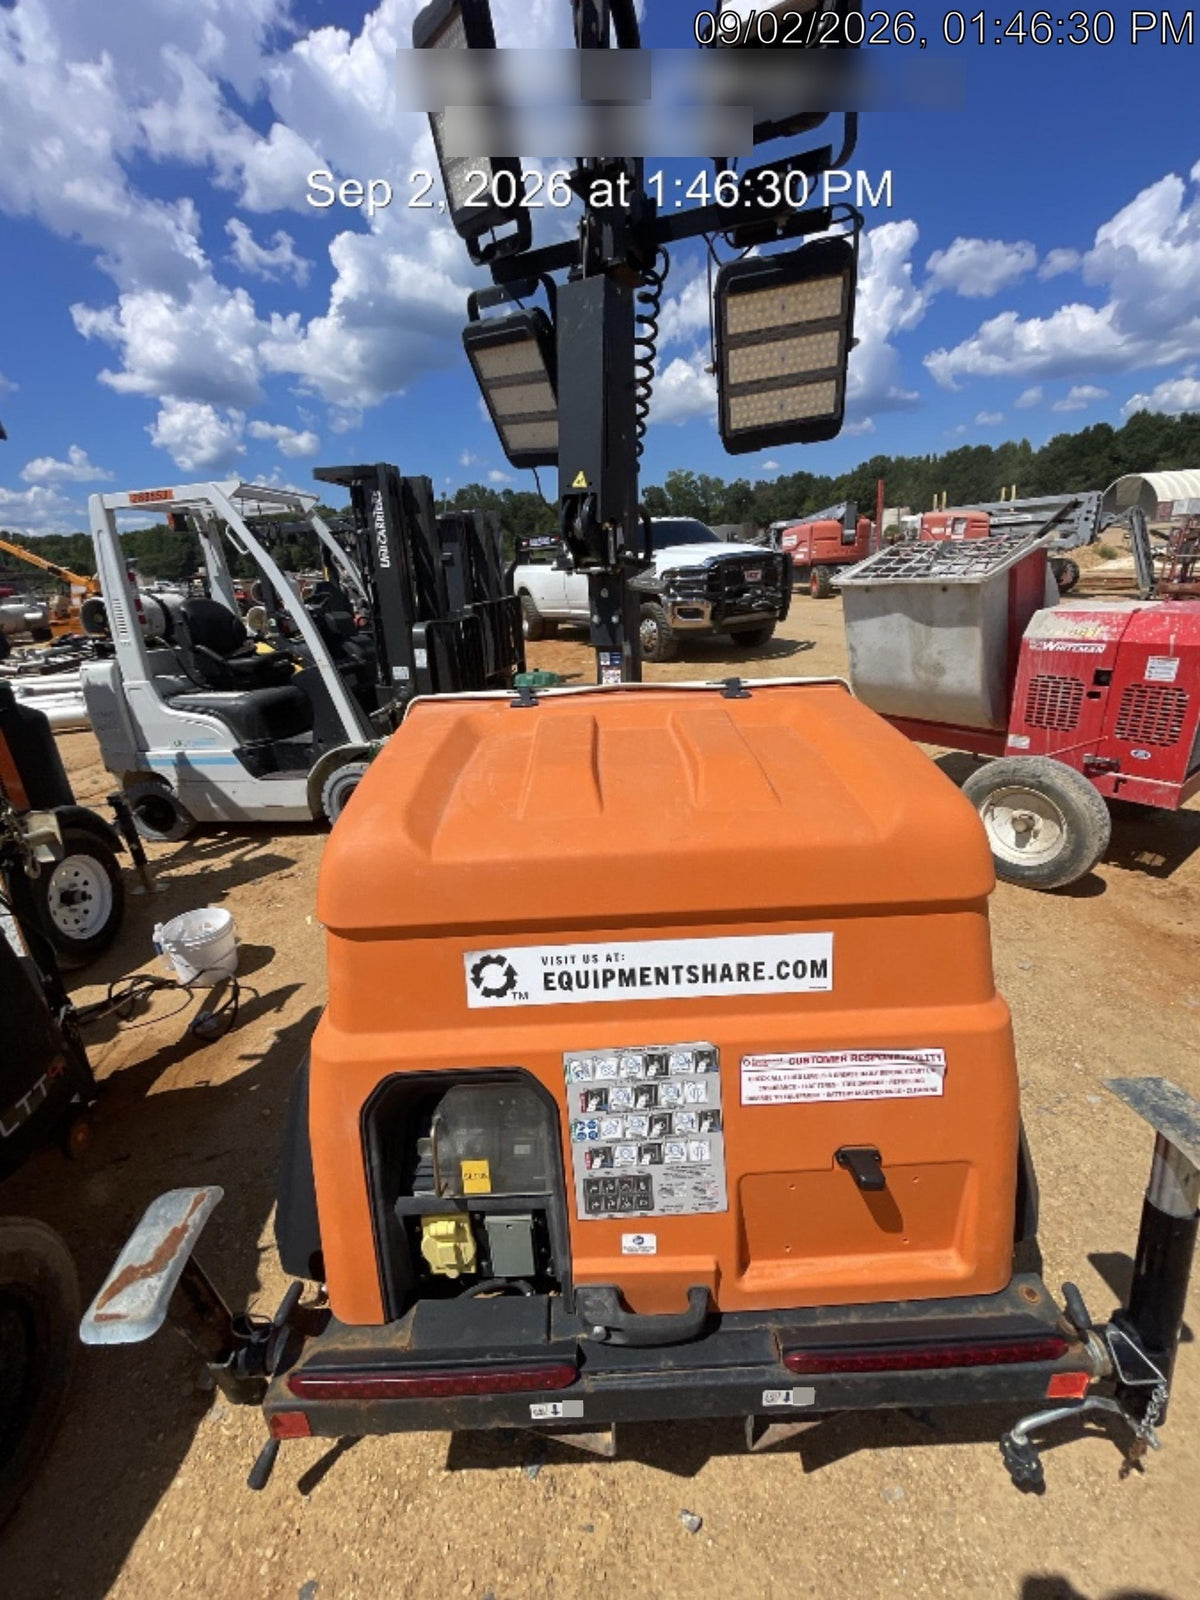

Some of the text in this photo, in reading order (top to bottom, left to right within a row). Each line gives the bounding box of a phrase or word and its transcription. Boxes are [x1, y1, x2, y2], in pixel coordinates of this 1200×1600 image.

[541, 952, 626, 966] VISIT US AT:
[543, 957, 829, 992] EQUIPMENTSHARE.COM
[511, 991, 529, 1001] TM
